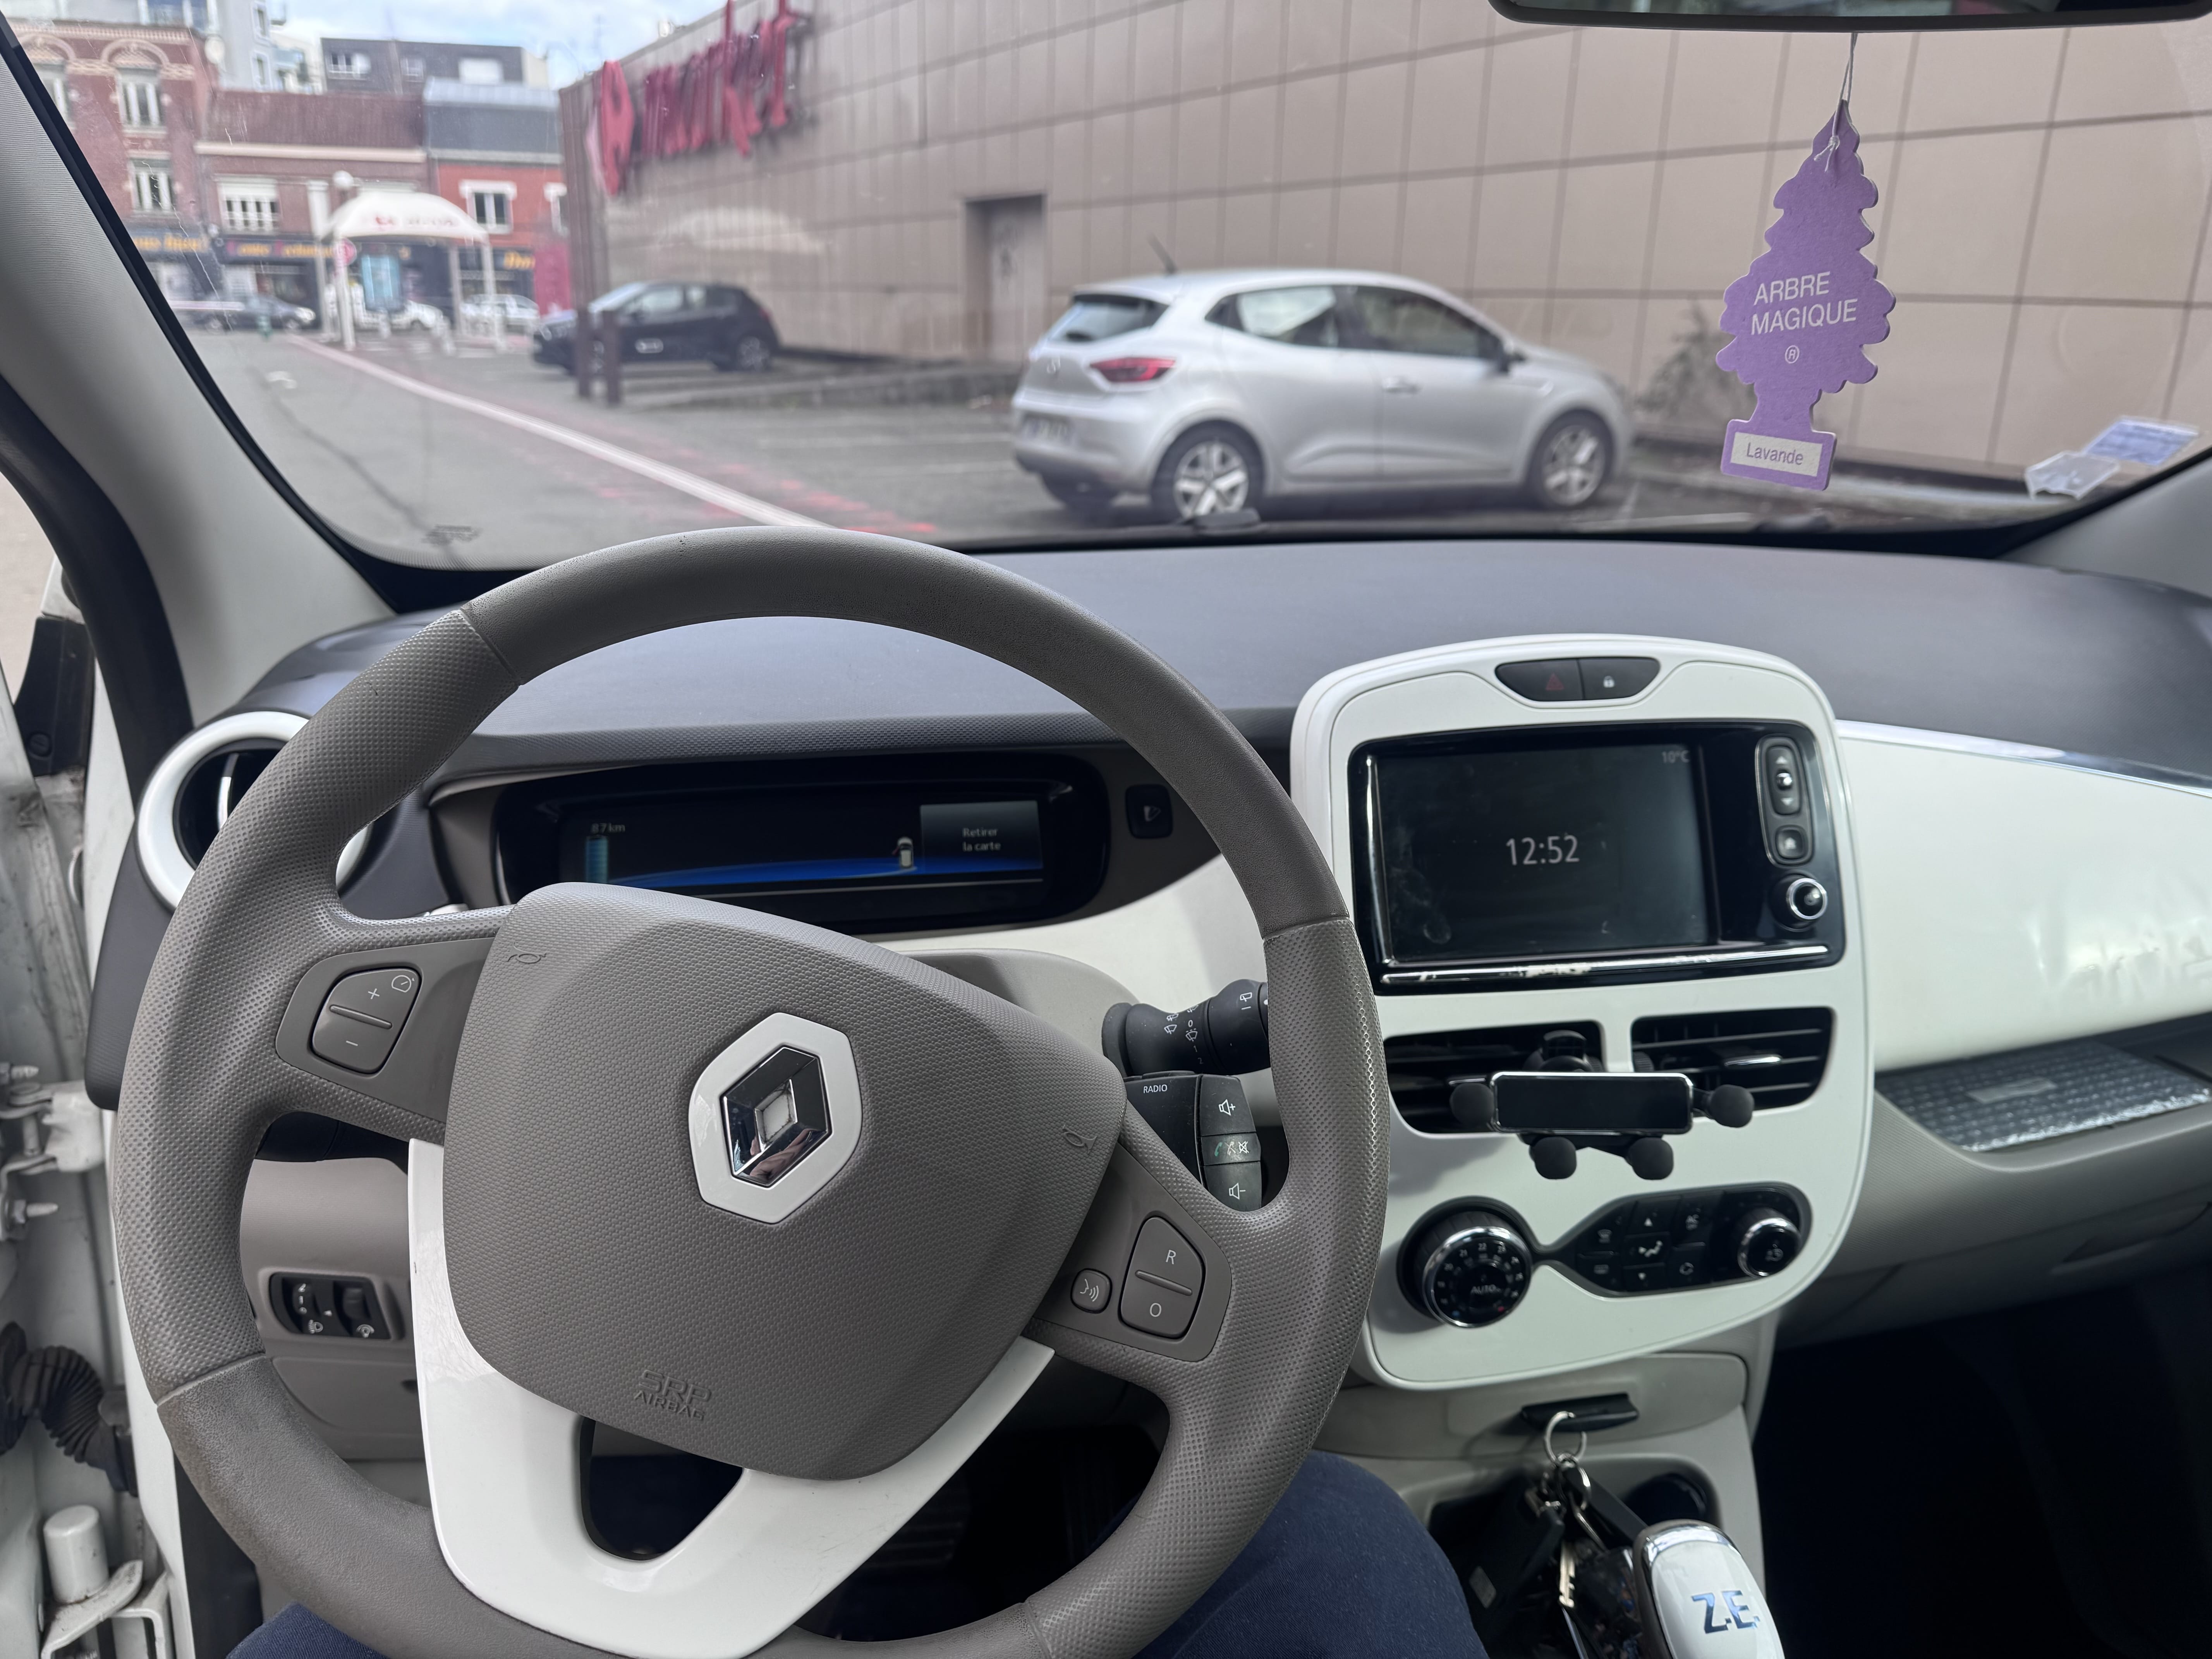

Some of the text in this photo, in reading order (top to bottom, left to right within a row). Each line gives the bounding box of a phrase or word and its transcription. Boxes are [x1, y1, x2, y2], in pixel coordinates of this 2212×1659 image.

[1753, 271, 1831, 306] ARBRE
[1750, 298, 1858, 335] MAGIQUE
[1746, 442, 1803, 465] Lavande
[1662, 750, 1690, 763] 10°C
[962, 827, 998, 838] Retirer
[962, 841, 1001, 852] la carte
[1506, 835, 1580, 866] 12:52
[1143, 1084, 1168, 1093] RADIO
[1166, 1250, 1176, 1264] R
[634, 1390, 706, 1421] AIRBAG
